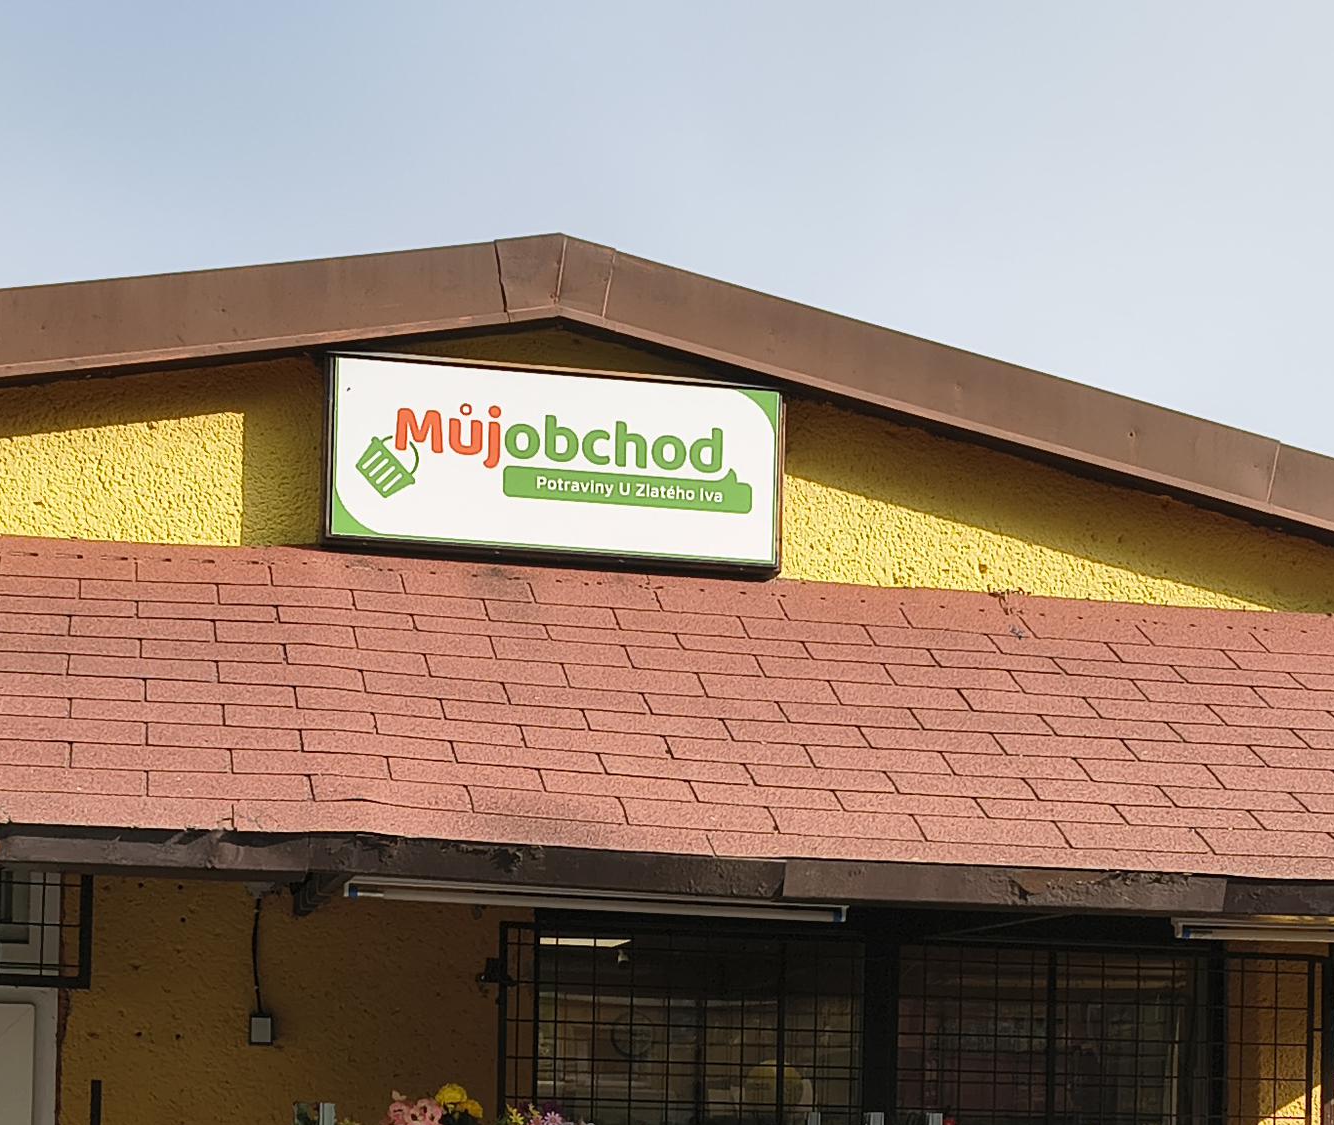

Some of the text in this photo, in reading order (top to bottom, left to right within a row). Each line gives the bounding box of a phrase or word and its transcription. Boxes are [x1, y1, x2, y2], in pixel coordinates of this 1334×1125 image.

[535, 475, 724, 503] Potraviny U Zlatého Iva
